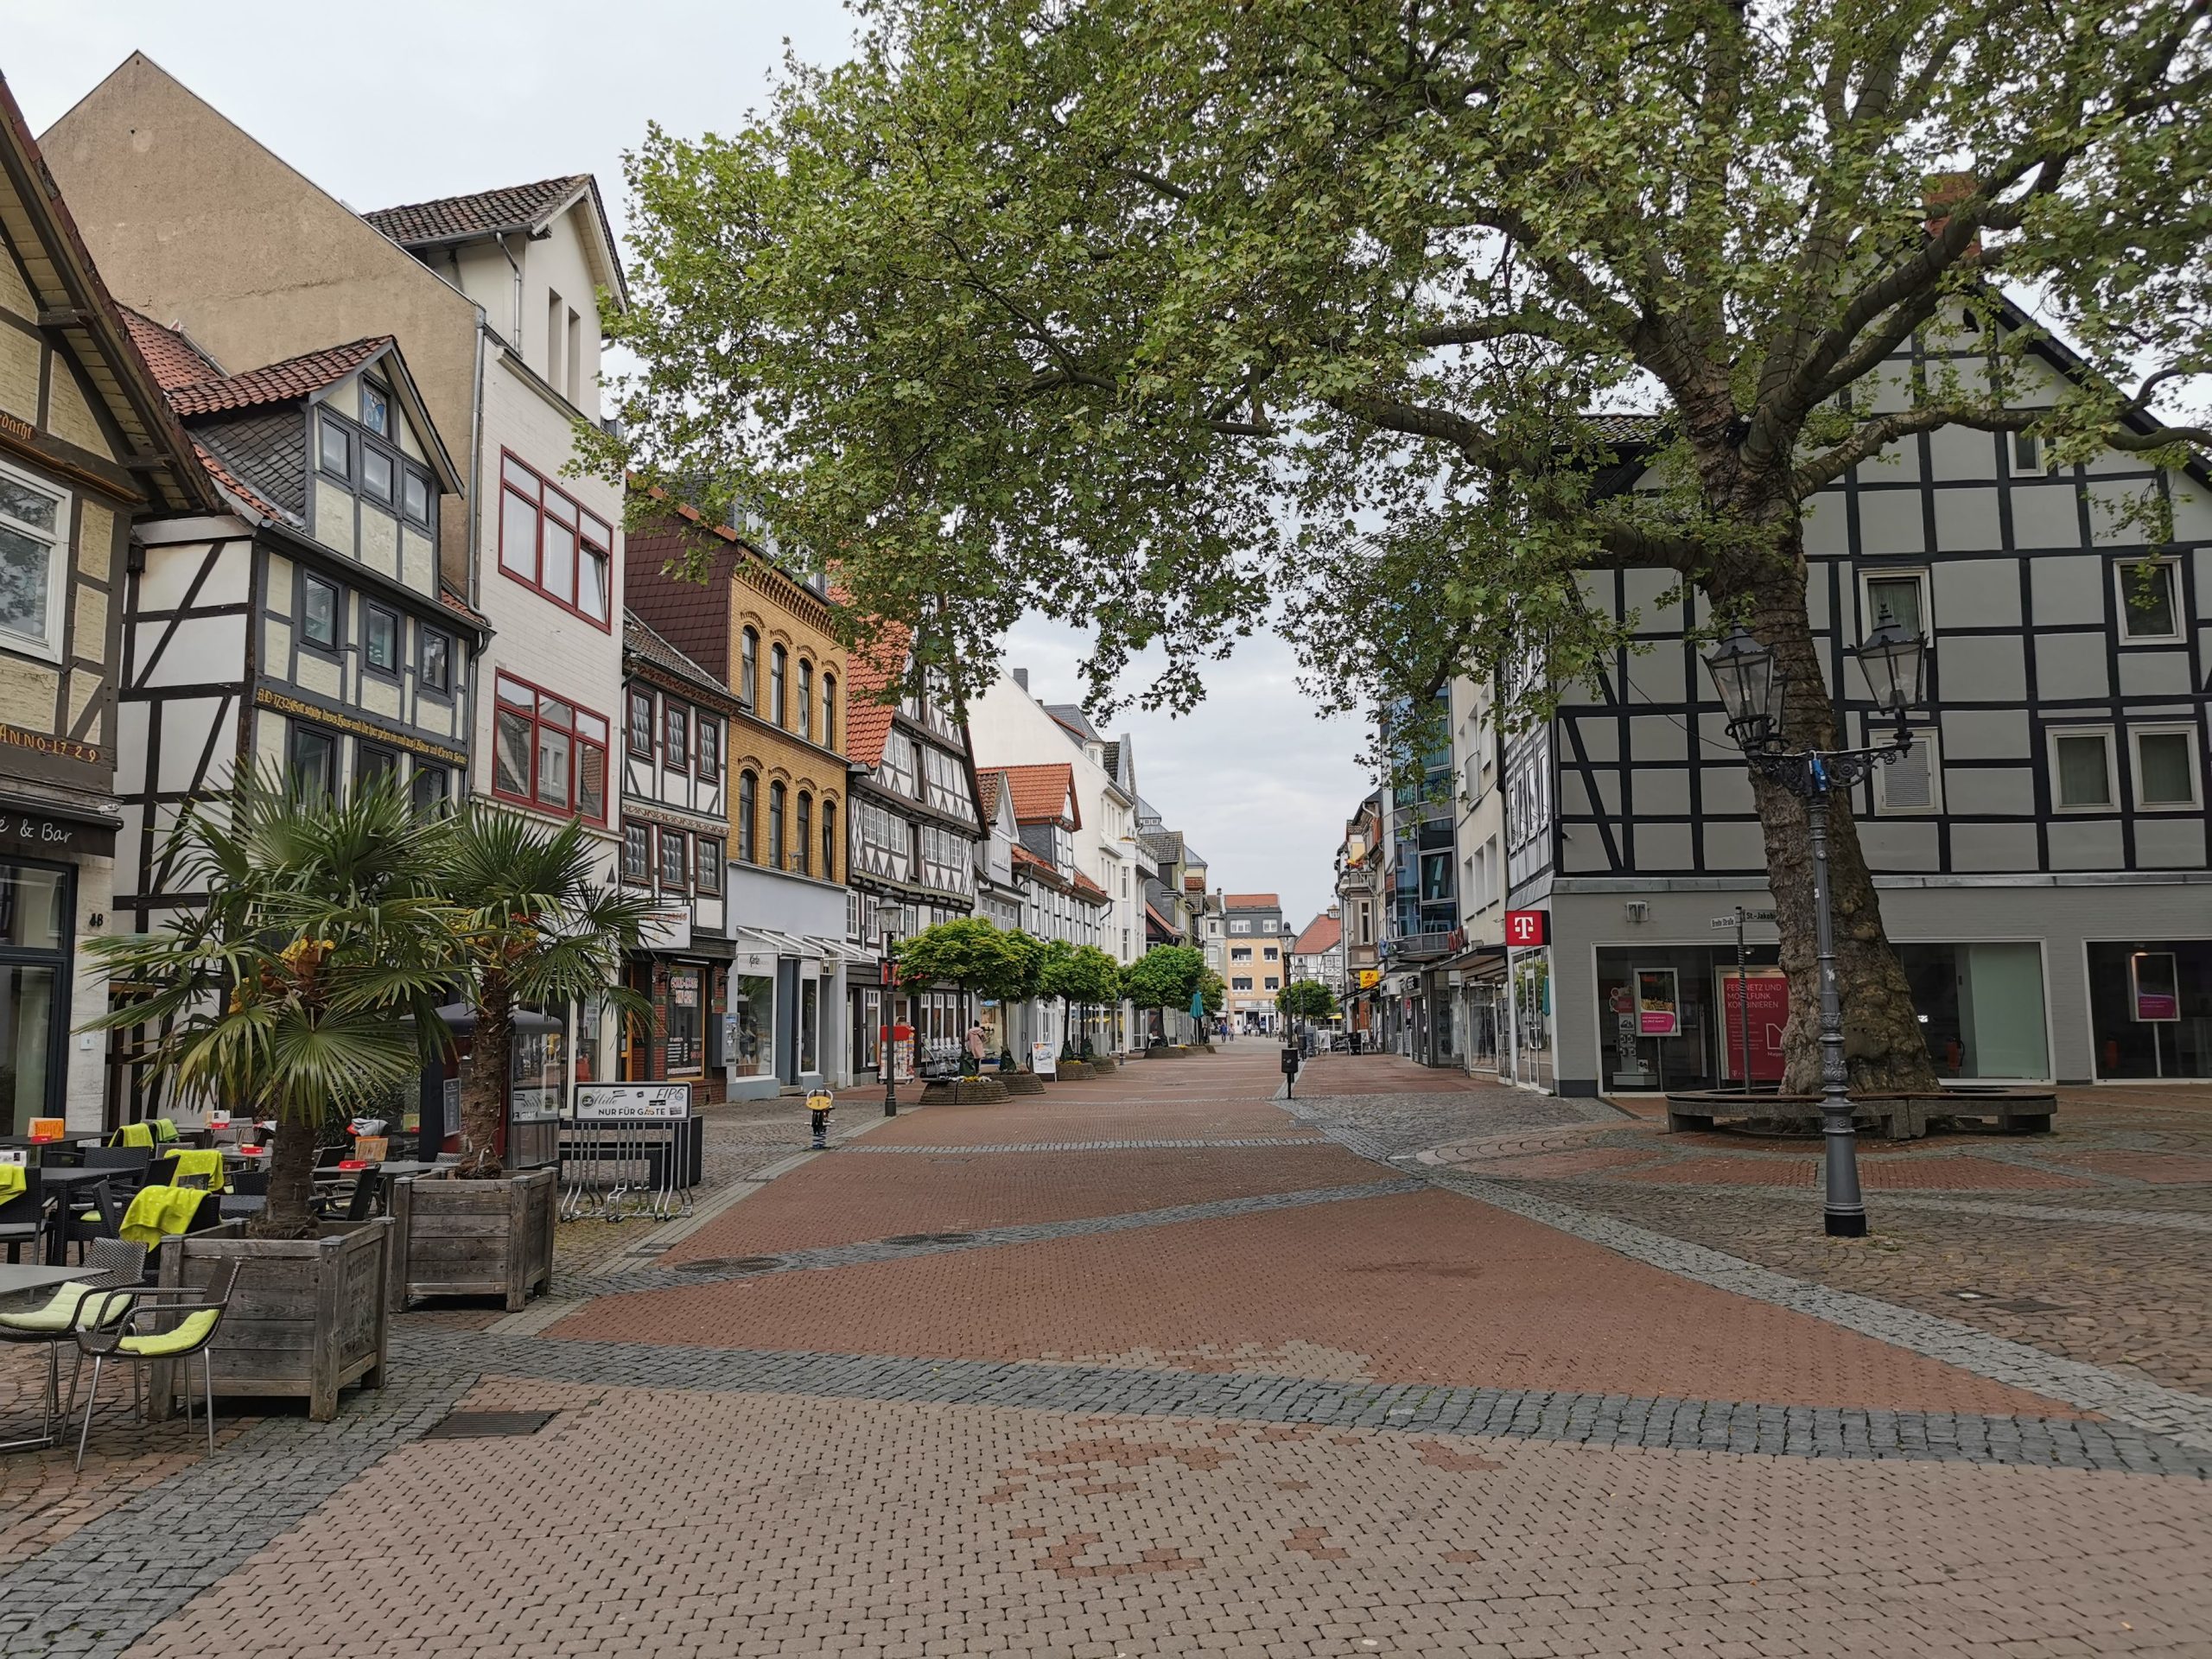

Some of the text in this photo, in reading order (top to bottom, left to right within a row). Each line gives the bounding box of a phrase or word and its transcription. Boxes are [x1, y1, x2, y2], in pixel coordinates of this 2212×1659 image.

[41, 822, 73, 843] Bar
[1514, 917, 1534, 939] T
[619, 1106, 636, 1116] FÜR
